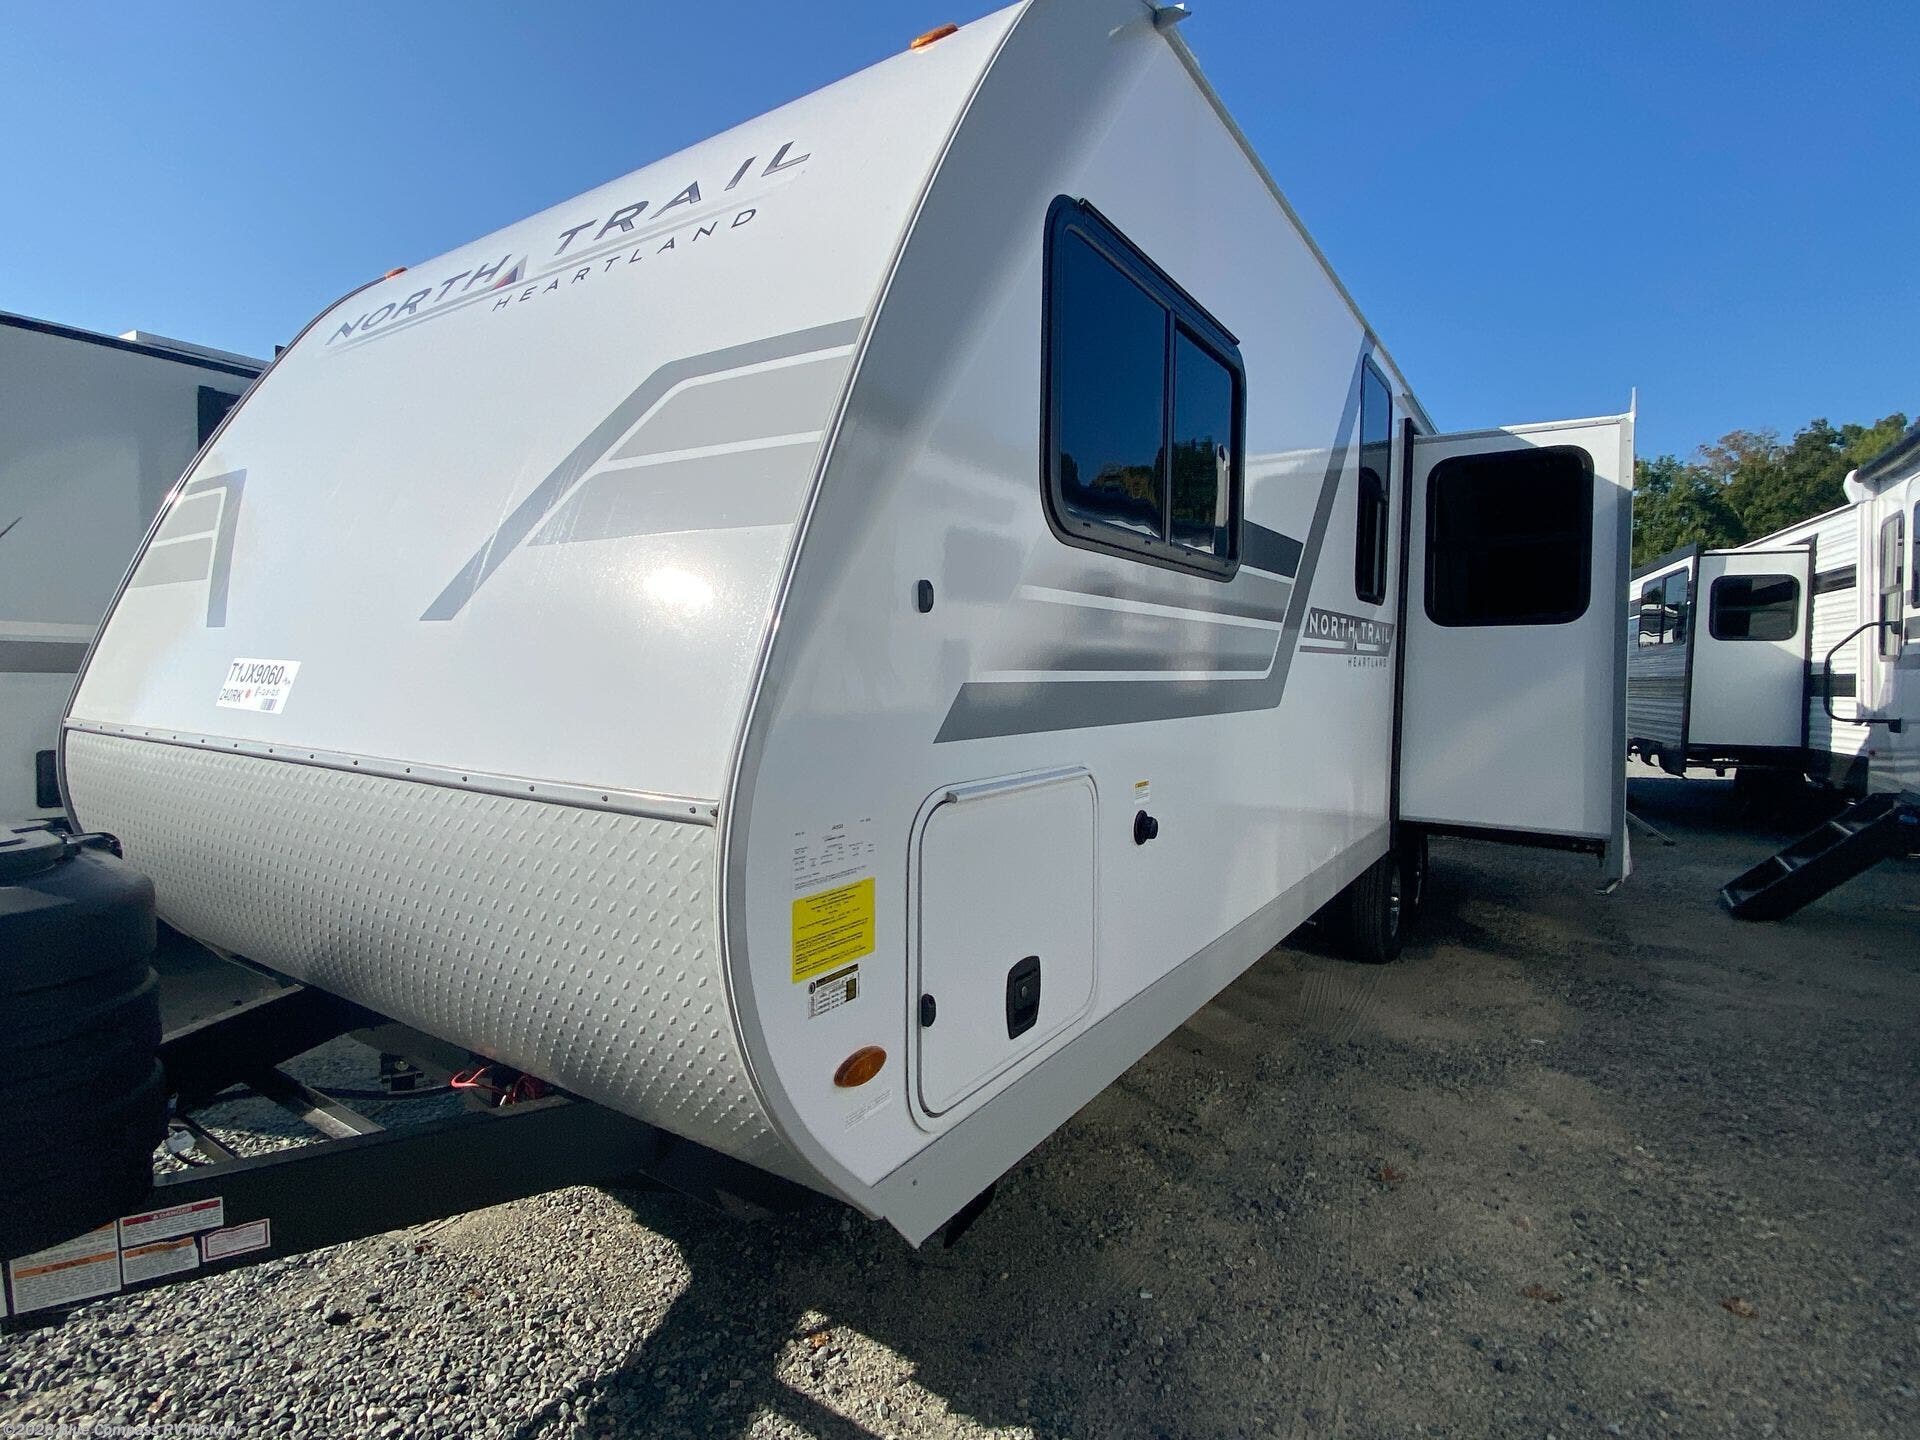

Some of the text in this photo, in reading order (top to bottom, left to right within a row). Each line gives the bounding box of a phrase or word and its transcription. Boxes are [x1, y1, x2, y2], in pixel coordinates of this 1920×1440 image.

[325, 140, 812, 346] NORTH TRAIL
[492, 207, 758, 313] HEARTLAND
[1309, 612, 1390, 644] NORTH TRAIL
[229, 662, 284, 685] T1JX9060
[1347, 656, 1387, 668] HEARTLAND
